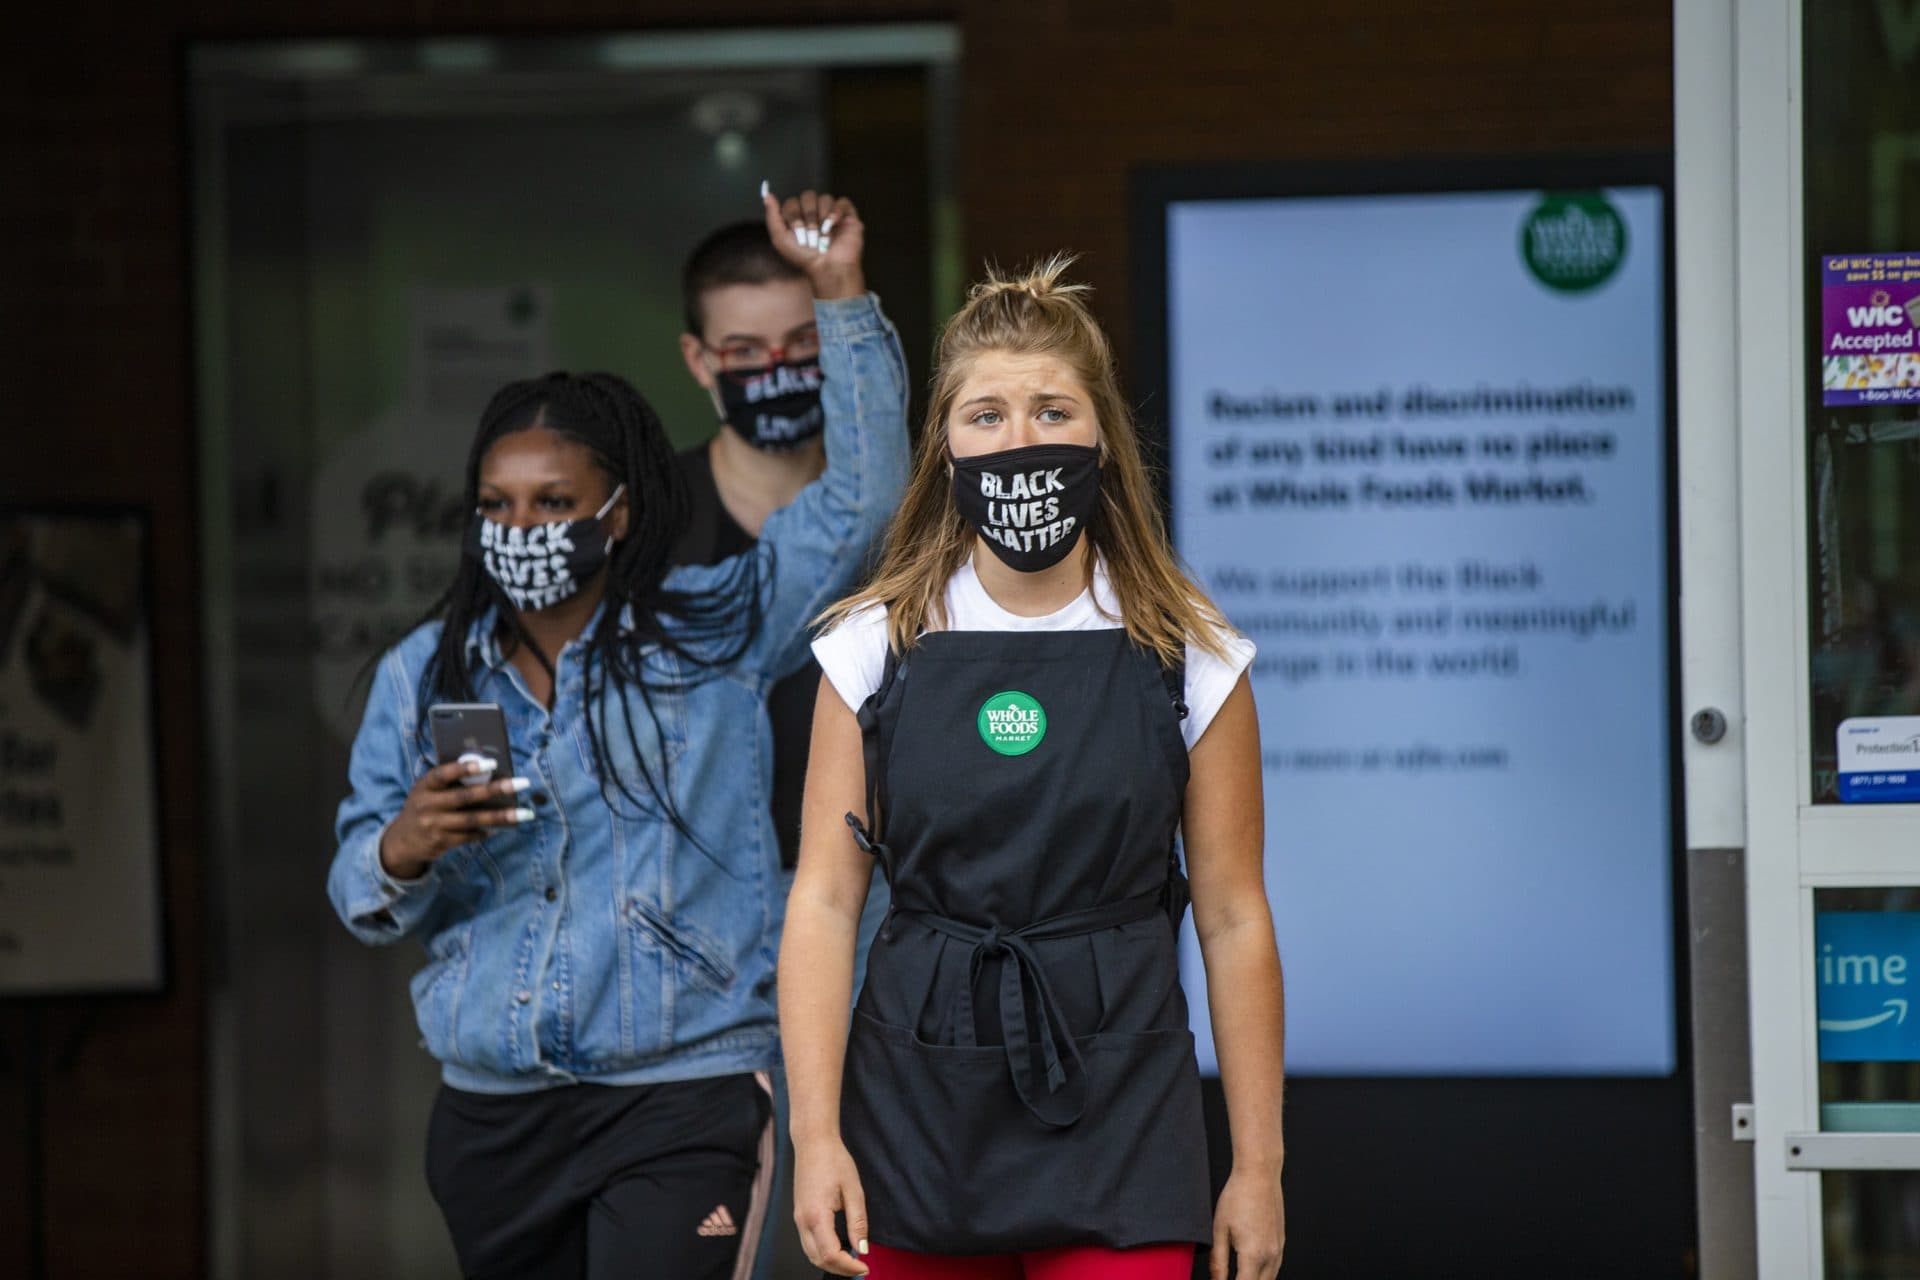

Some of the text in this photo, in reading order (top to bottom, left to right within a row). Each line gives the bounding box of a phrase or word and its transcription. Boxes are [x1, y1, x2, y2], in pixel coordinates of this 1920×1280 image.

[1847, 305, 1903, 327] WIC
[1830, 329, 1913, 353] Accepted
[1208, 384, 1634, 420] Racism and discrimination
[1249, 439, 1302, 468] any
[1312, 431, 1383, 460] kind
[1391, 429, 1468, 459] have
[1480, 433, 1518, 458] no
[1524, 428, 1617, 465] place
[980, 467, 1065, 500] BLACK
[1248, 474, 1348, 505] Whole
[1360, 471, 1454, 502] Foods
[988, 497, 1059, 528] LIVES
[480, 518, 576, 558] BLACK
[483, 551, 570, 589] LIVES
[986, 706, 1039, 722] WHOLE
[990, 722, 1038, 735] FOODS
[995, 734, 1032, 742] MARKET
[1823, 943, 1907, 985] ime
